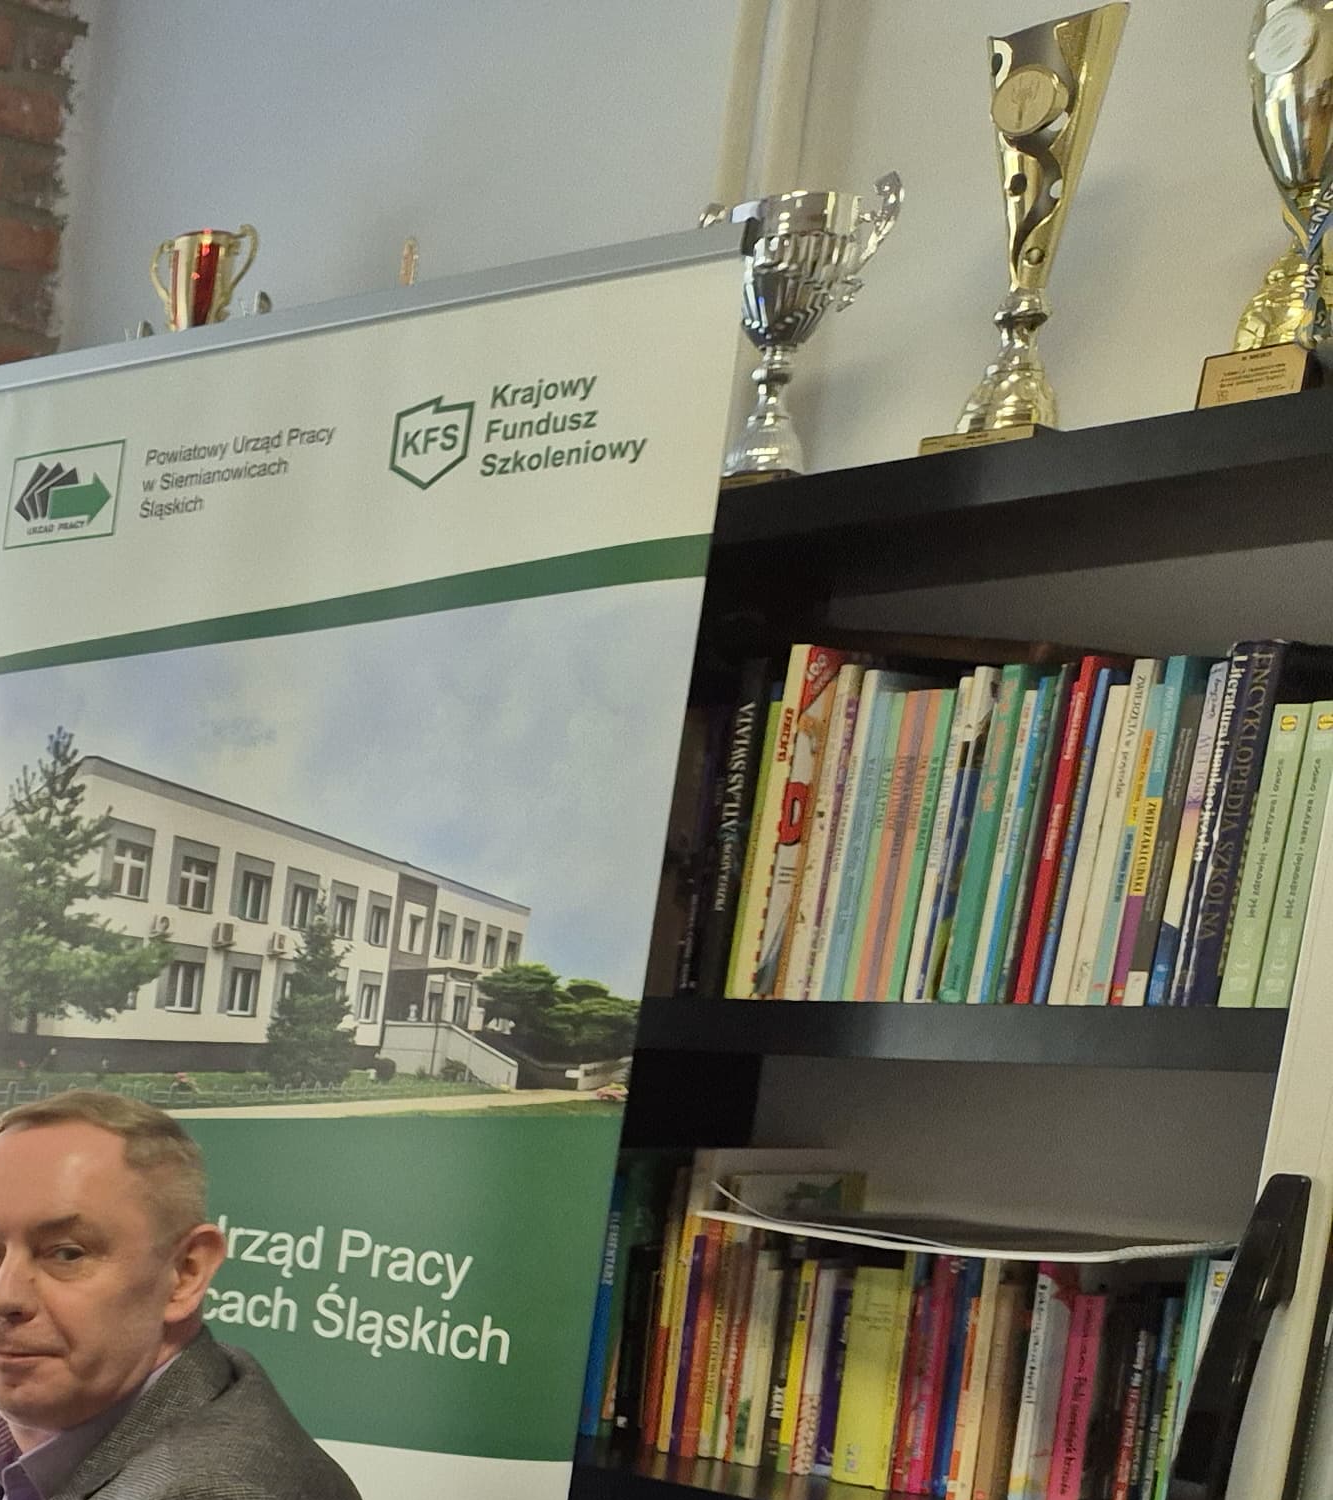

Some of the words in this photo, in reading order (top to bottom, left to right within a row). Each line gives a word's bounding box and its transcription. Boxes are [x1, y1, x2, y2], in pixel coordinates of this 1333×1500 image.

[490, 371, 597, 409] Krajowy
[402, 423, 460, 459] KFS
[485, 407, 598, 444] Fundusz
[146, 440, 228, 466] Powiatowy
[233, 431, 282, 454] Urząd
[287, 427, 336, 446] Pracy
[479, 434, 646, 478] Szkoleniowy
[142, 480, 155, 492] w
[160, 457, 289, 491] Siemianowicach
[140, 495, 204, 520] Śląskich
[1220, 649, 1275, 834] ENCYKLOPEDIA
[1270, 757, 1286, 792] owoce
[1308, 757, 1324, 792] owoce
[721, 772, 745, 832] ATLAS
[1261, 798, 1280, 845] warzywa
[1298, 798, 1316, 846] warzywa
[1248, 852, 1269, 896] zdrowiej
[1286, 852, 1306, 897] zdrowiej
[1244, 896, 1260, 919] jeść
[1281, 896, 1298, 920] jeść
[338, 1227, 474, 1302] Pracy
[312, 1285, 512, 1365] Śląskich
